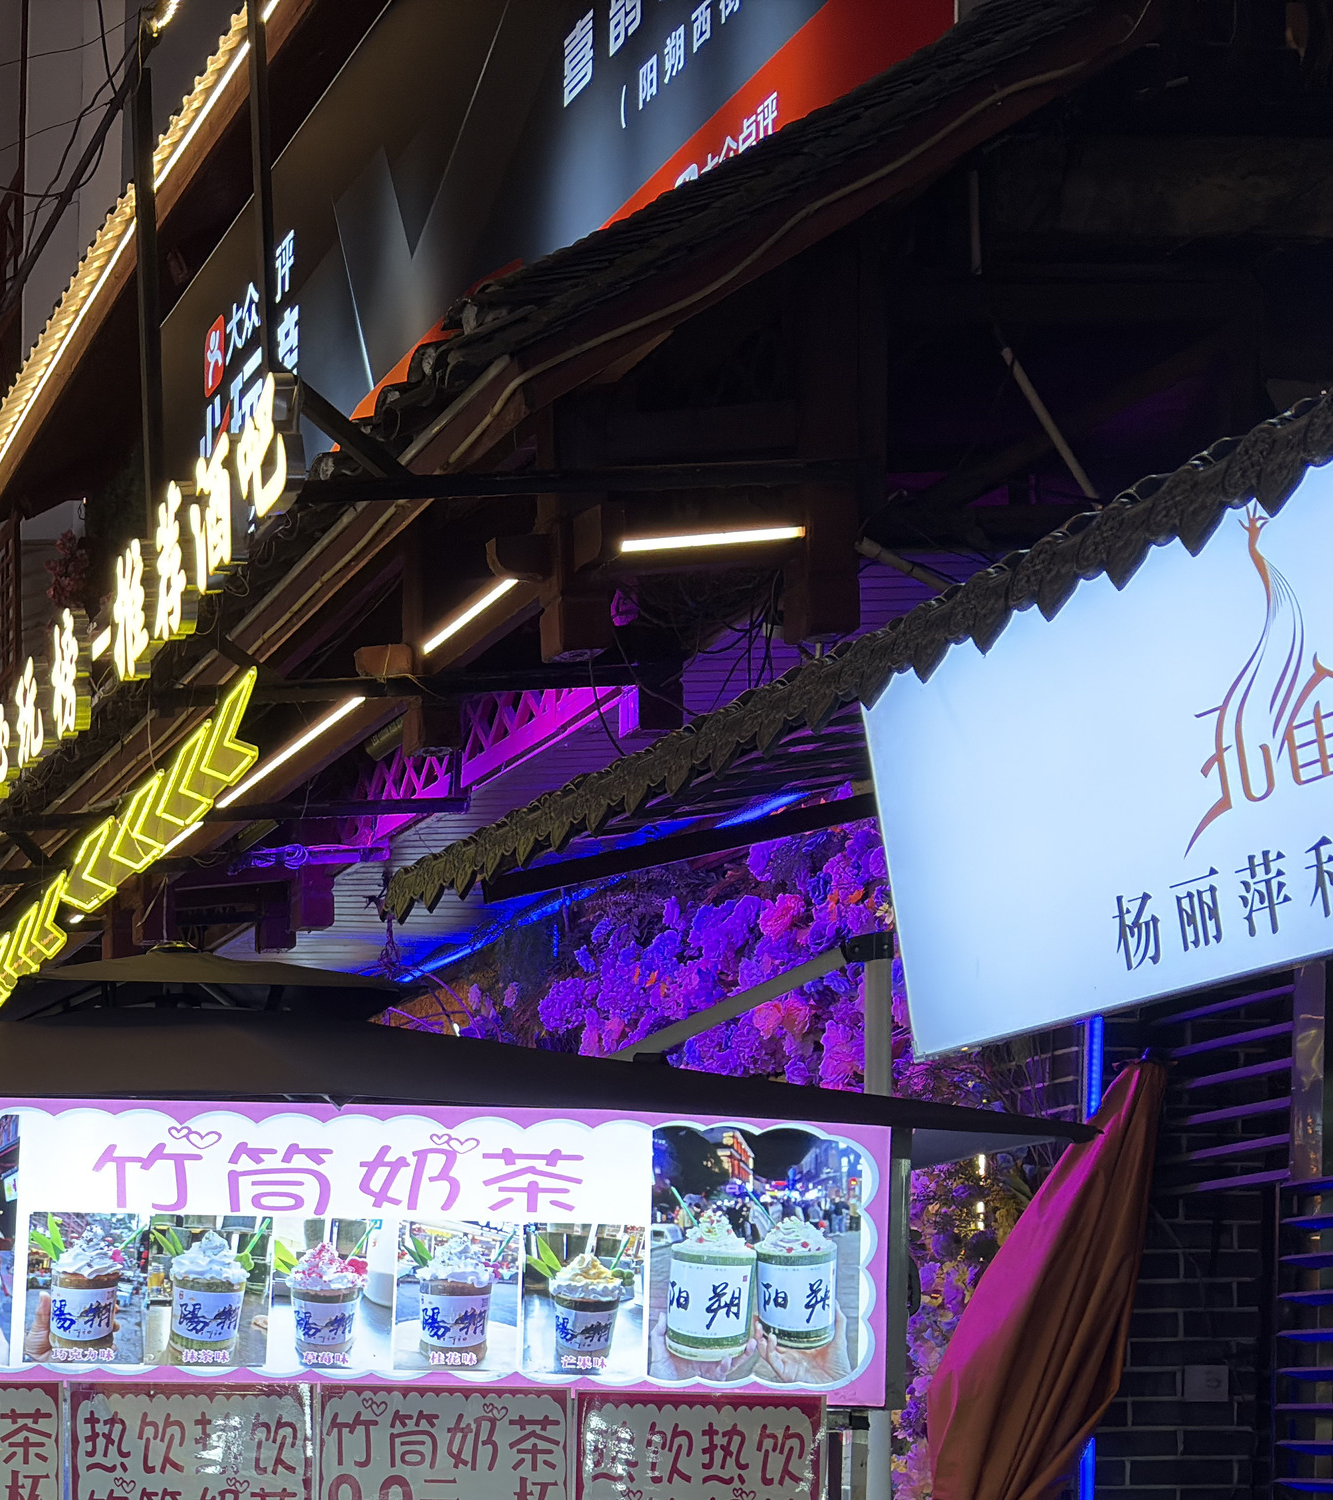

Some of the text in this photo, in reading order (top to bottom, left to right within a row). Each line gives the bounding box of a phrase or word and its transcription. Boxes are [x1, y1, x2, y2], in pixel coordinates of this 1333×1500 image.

[225, 229, 295, 366] 大众评
[91, 1142, 586, 1216] 竹筒奶茶
[667, 1279, 742, 1331] 阳朔
[51, 1347, 608, 1371] 巧克力味 抹茶味 草莓味 桂花味 芒果味
[83, 1409, 299, 1477] 热饮热饮
[325, 1407, 563, 1474] 竹筒奶茶
[589, 1420, 807, 1488] 热饮热饮
